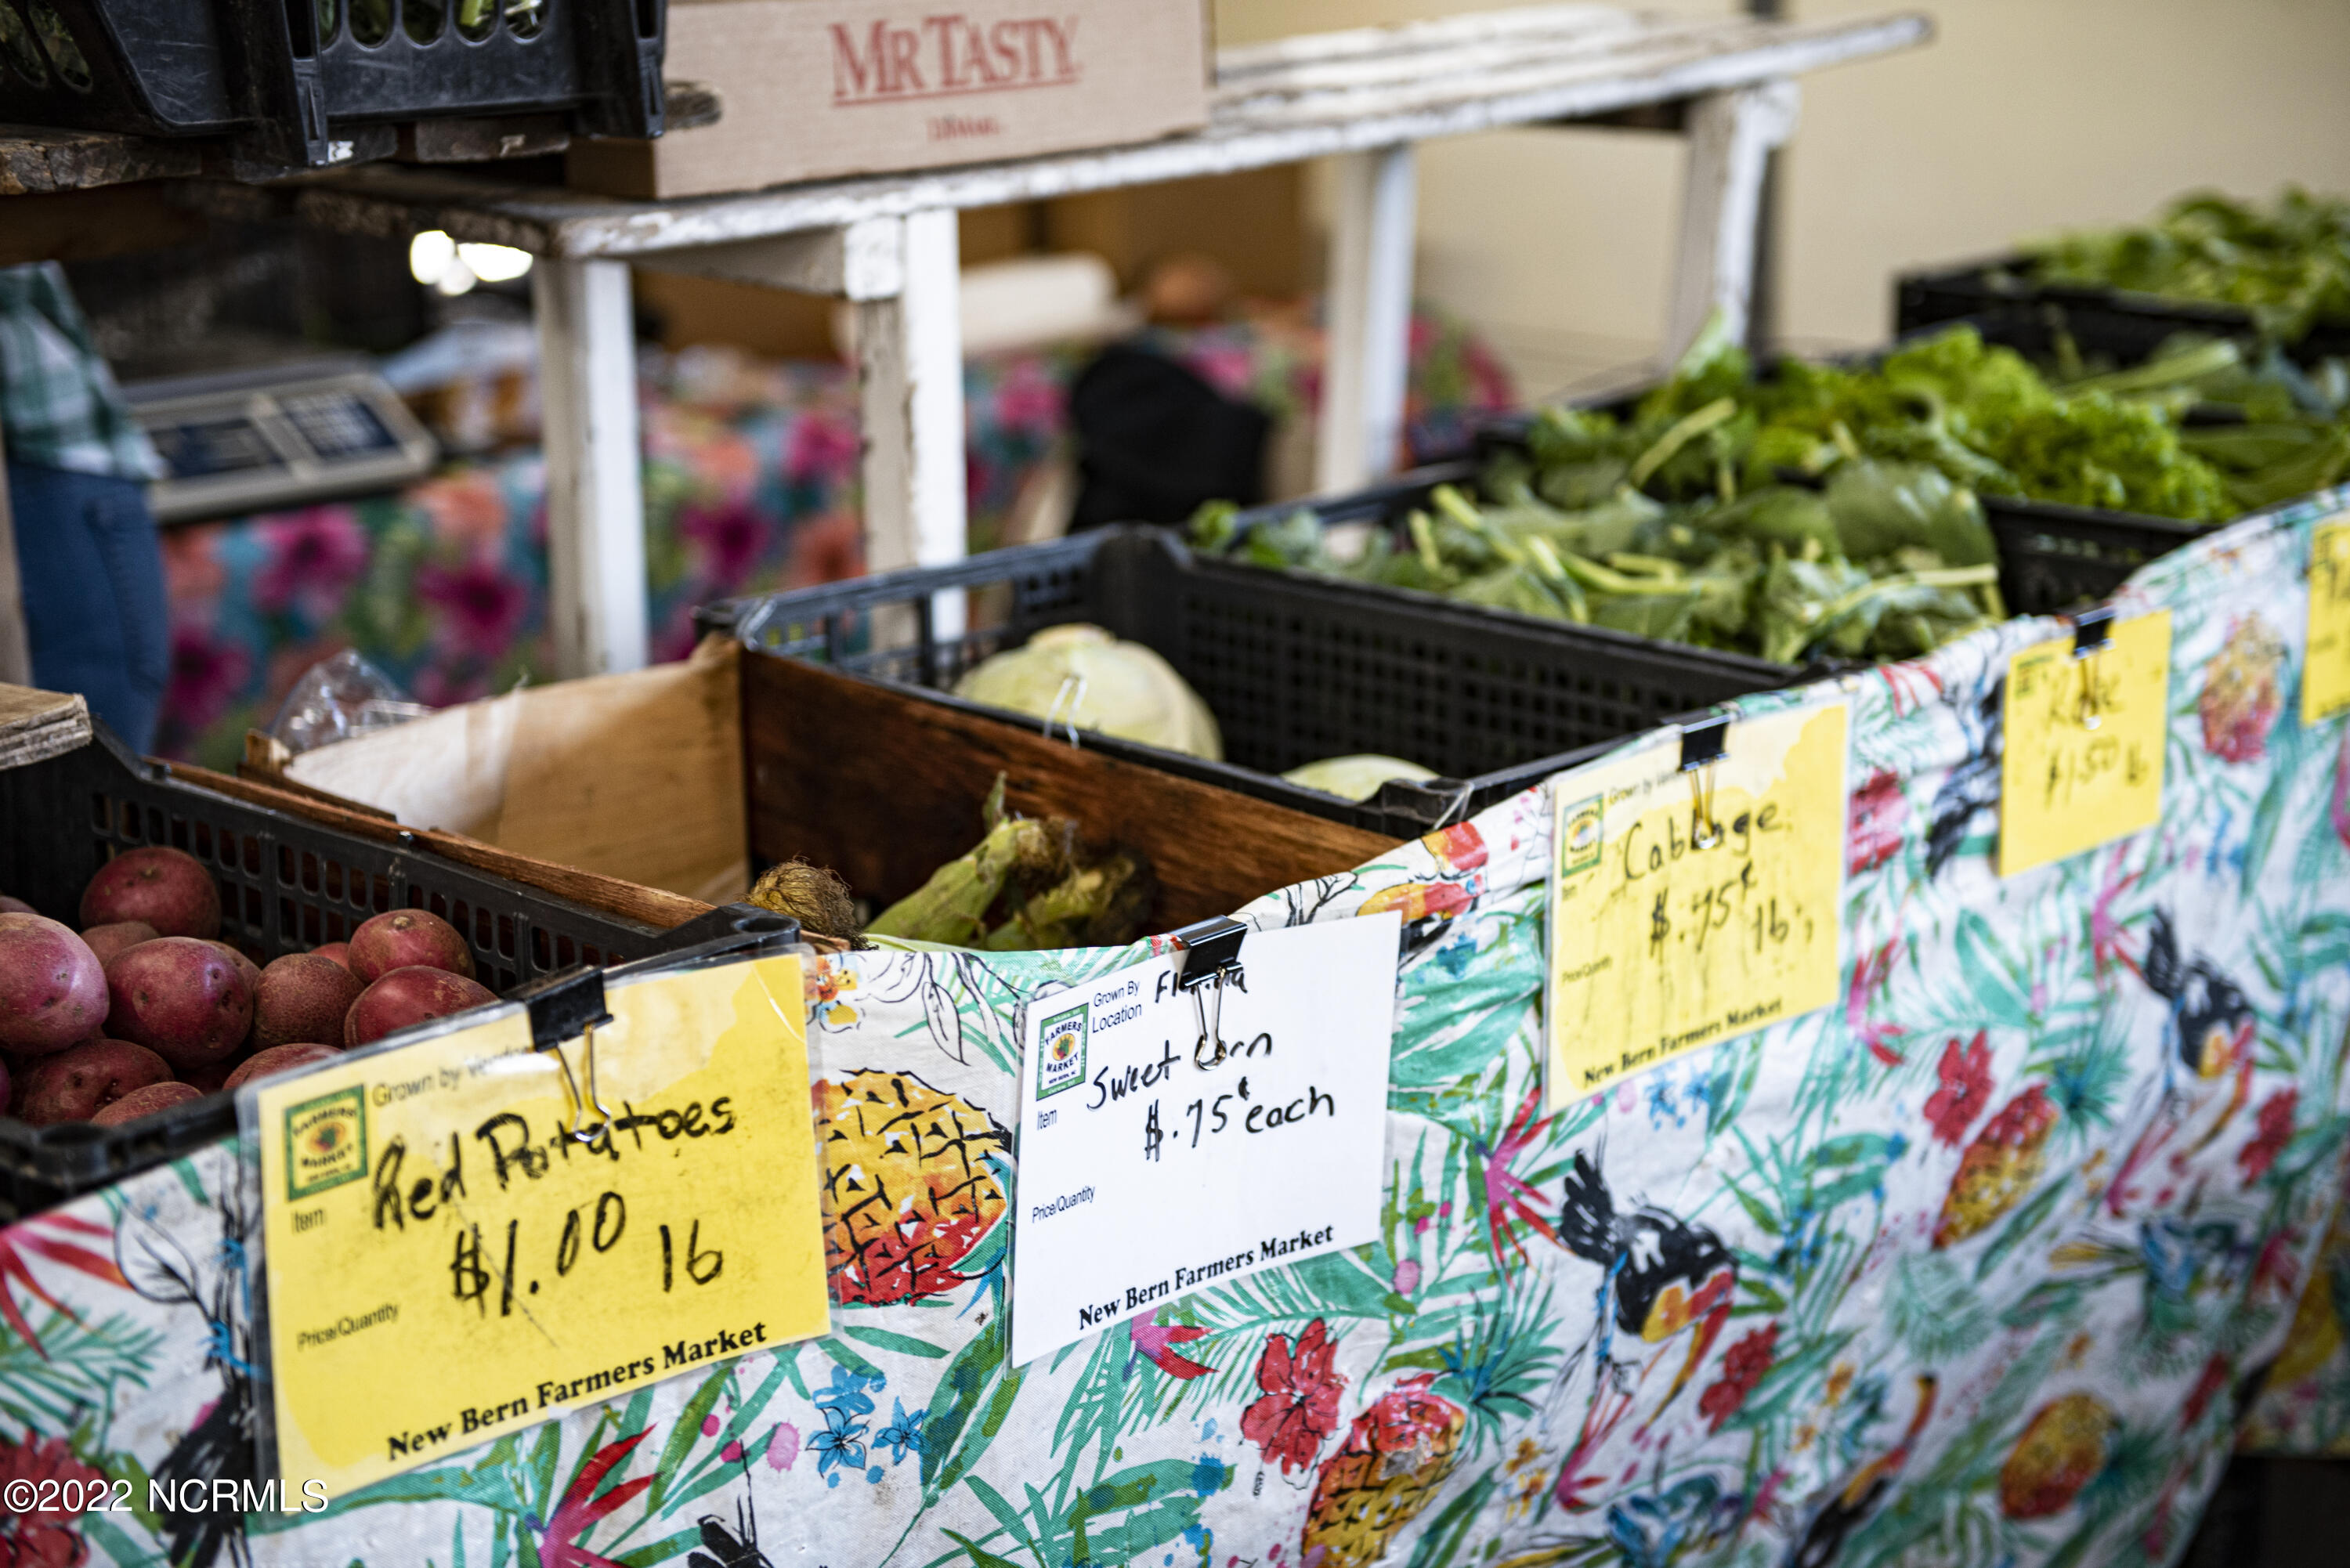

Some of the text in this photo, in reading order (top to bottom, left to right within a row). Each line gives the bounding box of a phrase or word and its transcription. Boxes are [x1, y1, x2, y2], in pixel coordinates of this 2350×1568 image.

[922, 13, 1083, 88] TASTY
[1094, 987, 1125, 1007] Grown
[1127, 980, 1141, 996] By
[1093, 1003, 1142, 1033] Location
[1046, 1052, 1079, 1073] MARKET
[1583, 998, 1782, 1089] New Bern Farmers Market
[371, 1075, 436, 1107] Grown
[1086, 1039, 1181, 1111] Sweet
[1037, 1109, 1058, 1131] Item
[1246, 1086, 1335, 1134] each
[373, 1097, 736, 1234] Red Potatoes
[292, 1207, 327, 1234] Item
[1032, 1185, 1096, 1224] Price/Quantity
[450, 1191, 626, 1319] $1.00
[1079, 1223, 1335, 1330] New Bern Farmers Market
[388, 1321, 767, 1461] New Bern Farmers Market
